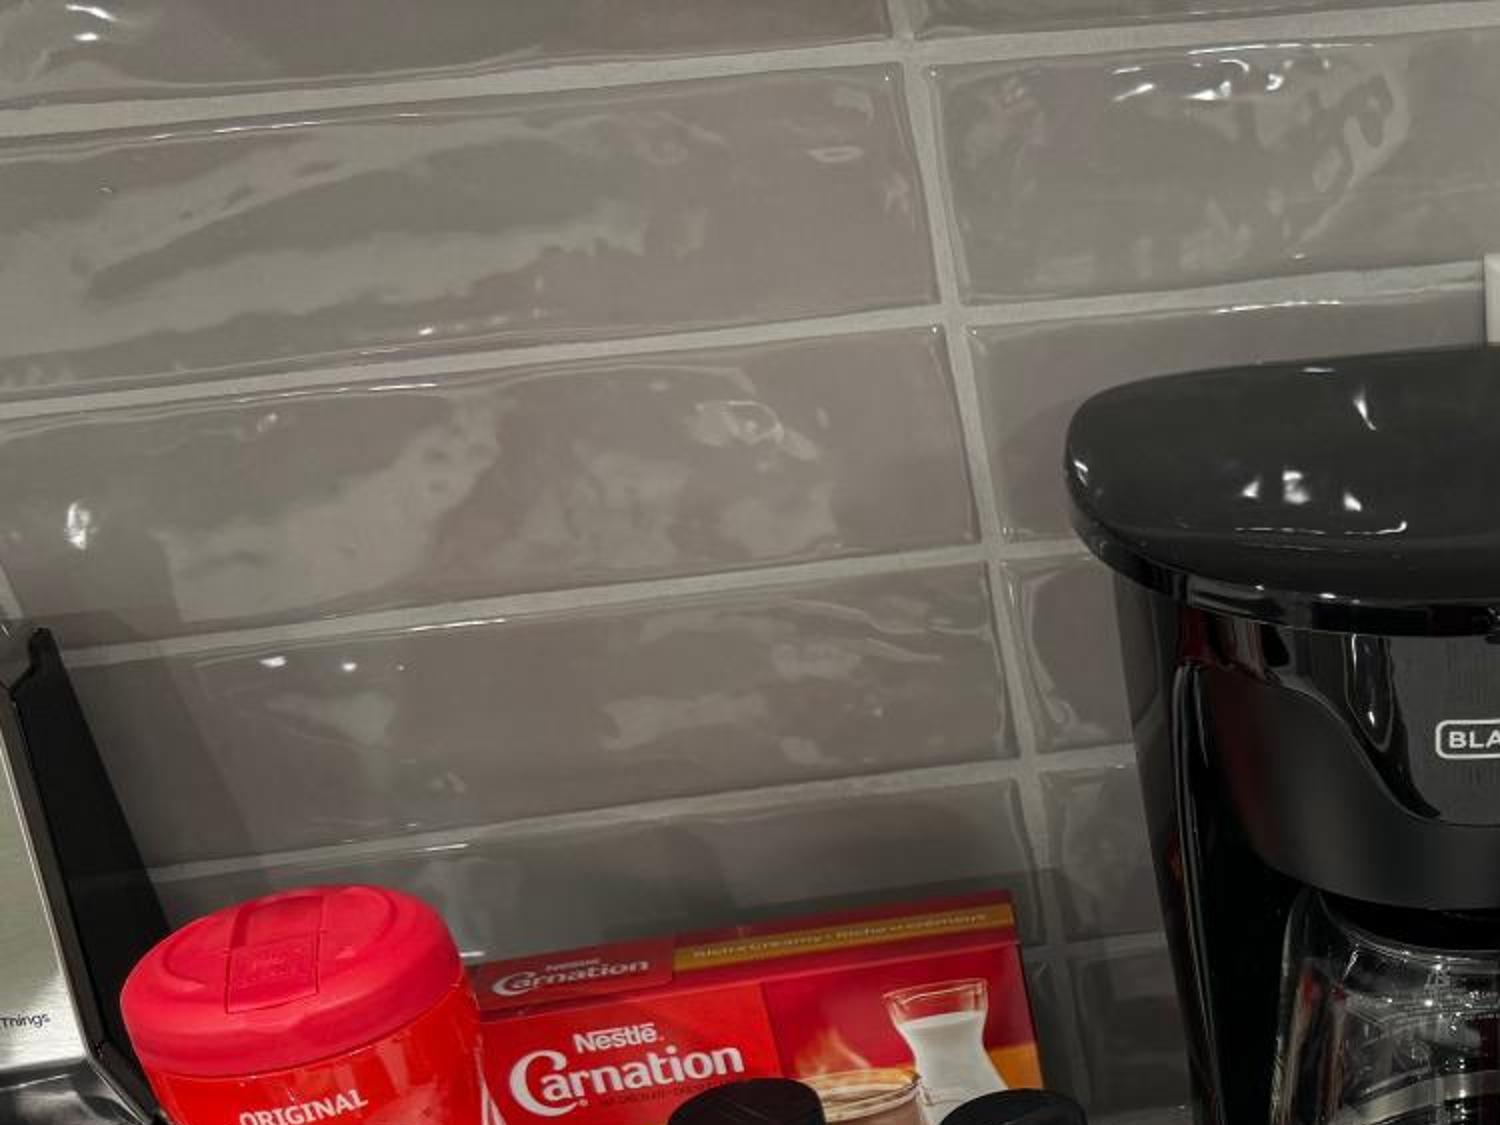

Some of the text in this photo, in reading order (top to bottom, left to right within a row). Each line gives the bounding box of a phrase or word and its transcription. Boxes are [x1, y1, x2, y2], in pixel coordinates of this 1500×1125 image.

[492, 960, 650, 997] Carnation
[573, 1022, 658, 1054] Nestlé
[509, 1045, 745, 1118] Carnation
